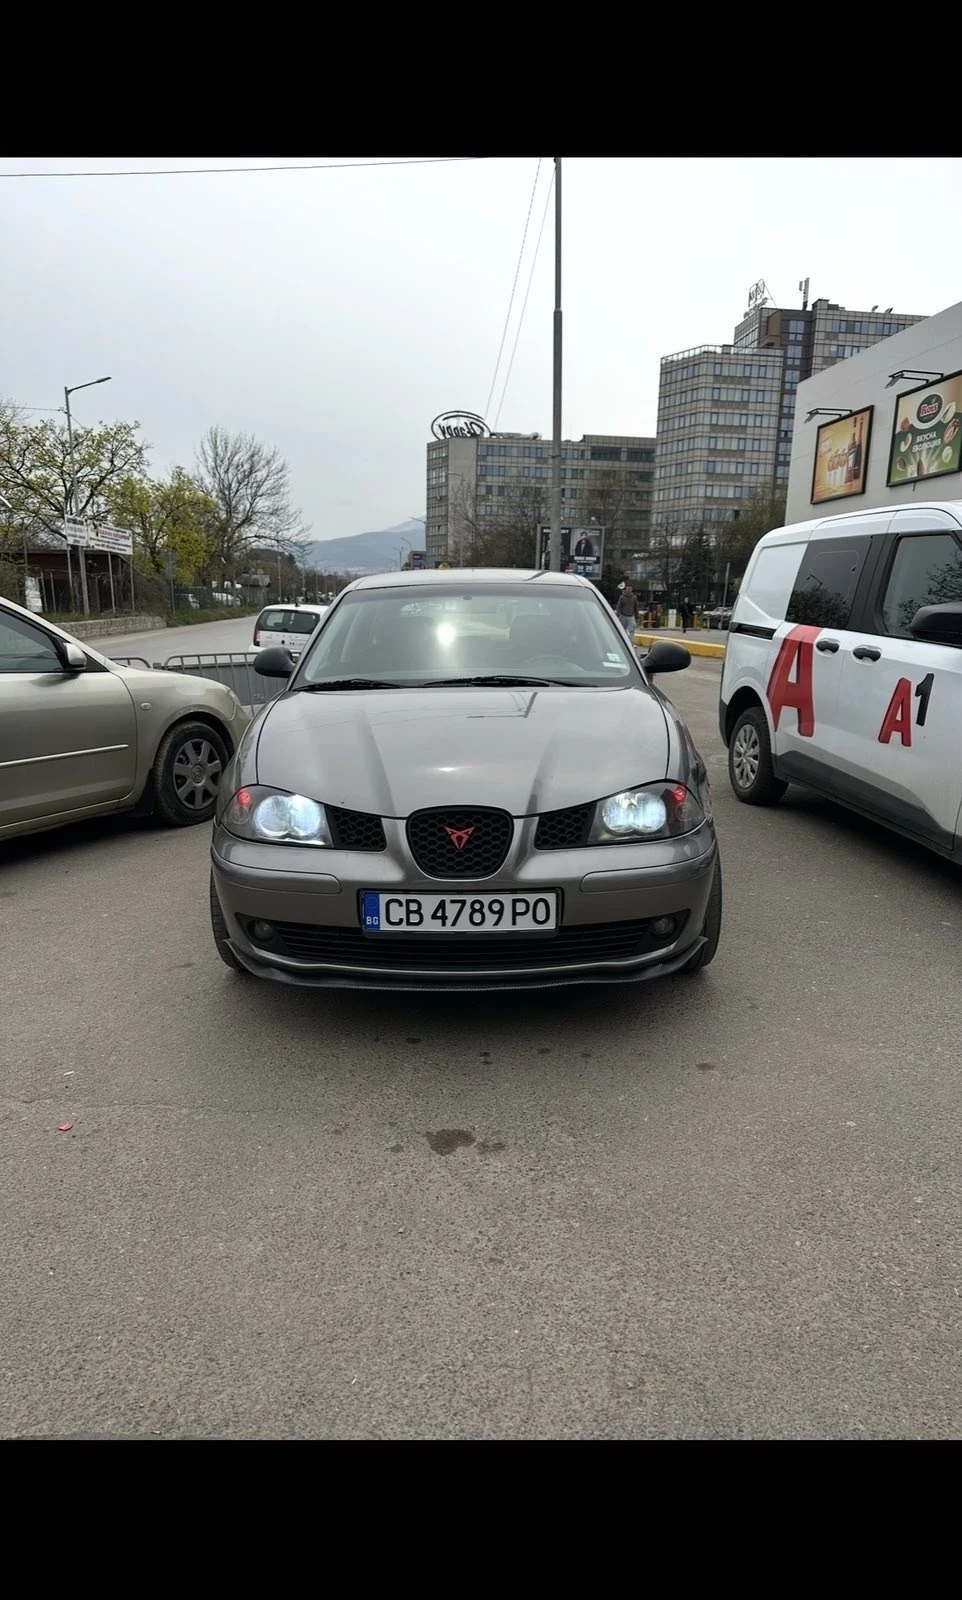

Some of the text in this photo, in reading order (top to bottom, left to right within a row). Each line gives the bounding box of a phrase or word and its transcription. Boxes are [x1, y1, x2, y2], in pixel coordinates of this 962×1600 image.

[916, 431, 937, 443] ВКУСНА
[912, 438, 942, 453] ЕВОЛЮЦИЯ
[878, 673, 935, 747] A1
[385, 898, 424, 926] CB
[431, 898, 505, 927] 4789
[366, 916, 379, 925] BG
